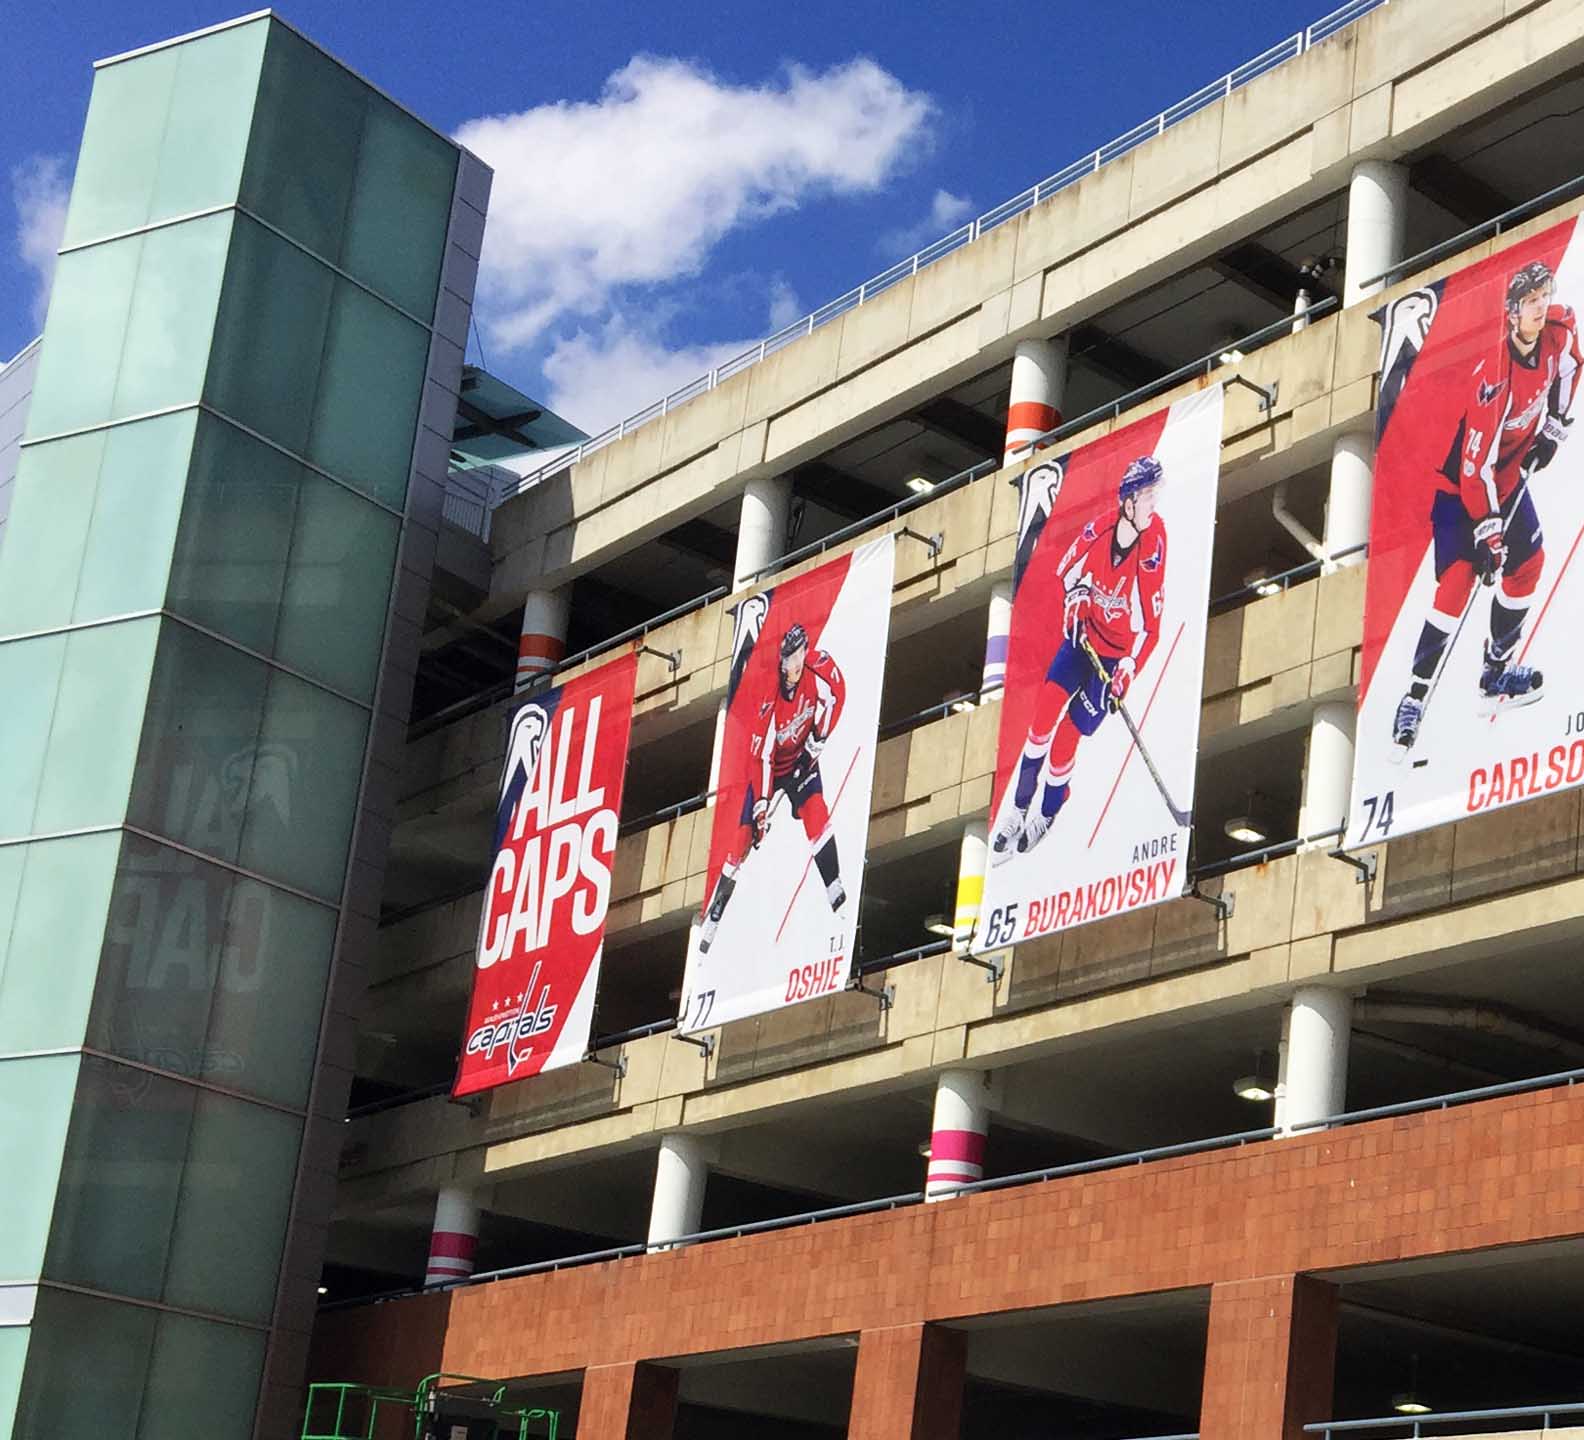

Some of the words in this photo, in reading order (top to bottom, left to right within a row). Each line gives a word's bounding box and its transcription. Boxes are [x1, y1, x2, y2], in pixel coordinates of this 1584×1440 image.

[512, 694, 606, 841] ALL
[1132, 833, 1177, 864] ANDRE
[1359, 791, 1395, 842] 74
[477, 808, 619, 969] CAPS
[984, 903, 1018, 948] 65
[1023, 858, 1176, 937] BURAKOVSKY
[692, 990, 716, 1029] 77
[785, 956, 843, 1003] OSHIE
[466, 960, 558, 1077] capitals
